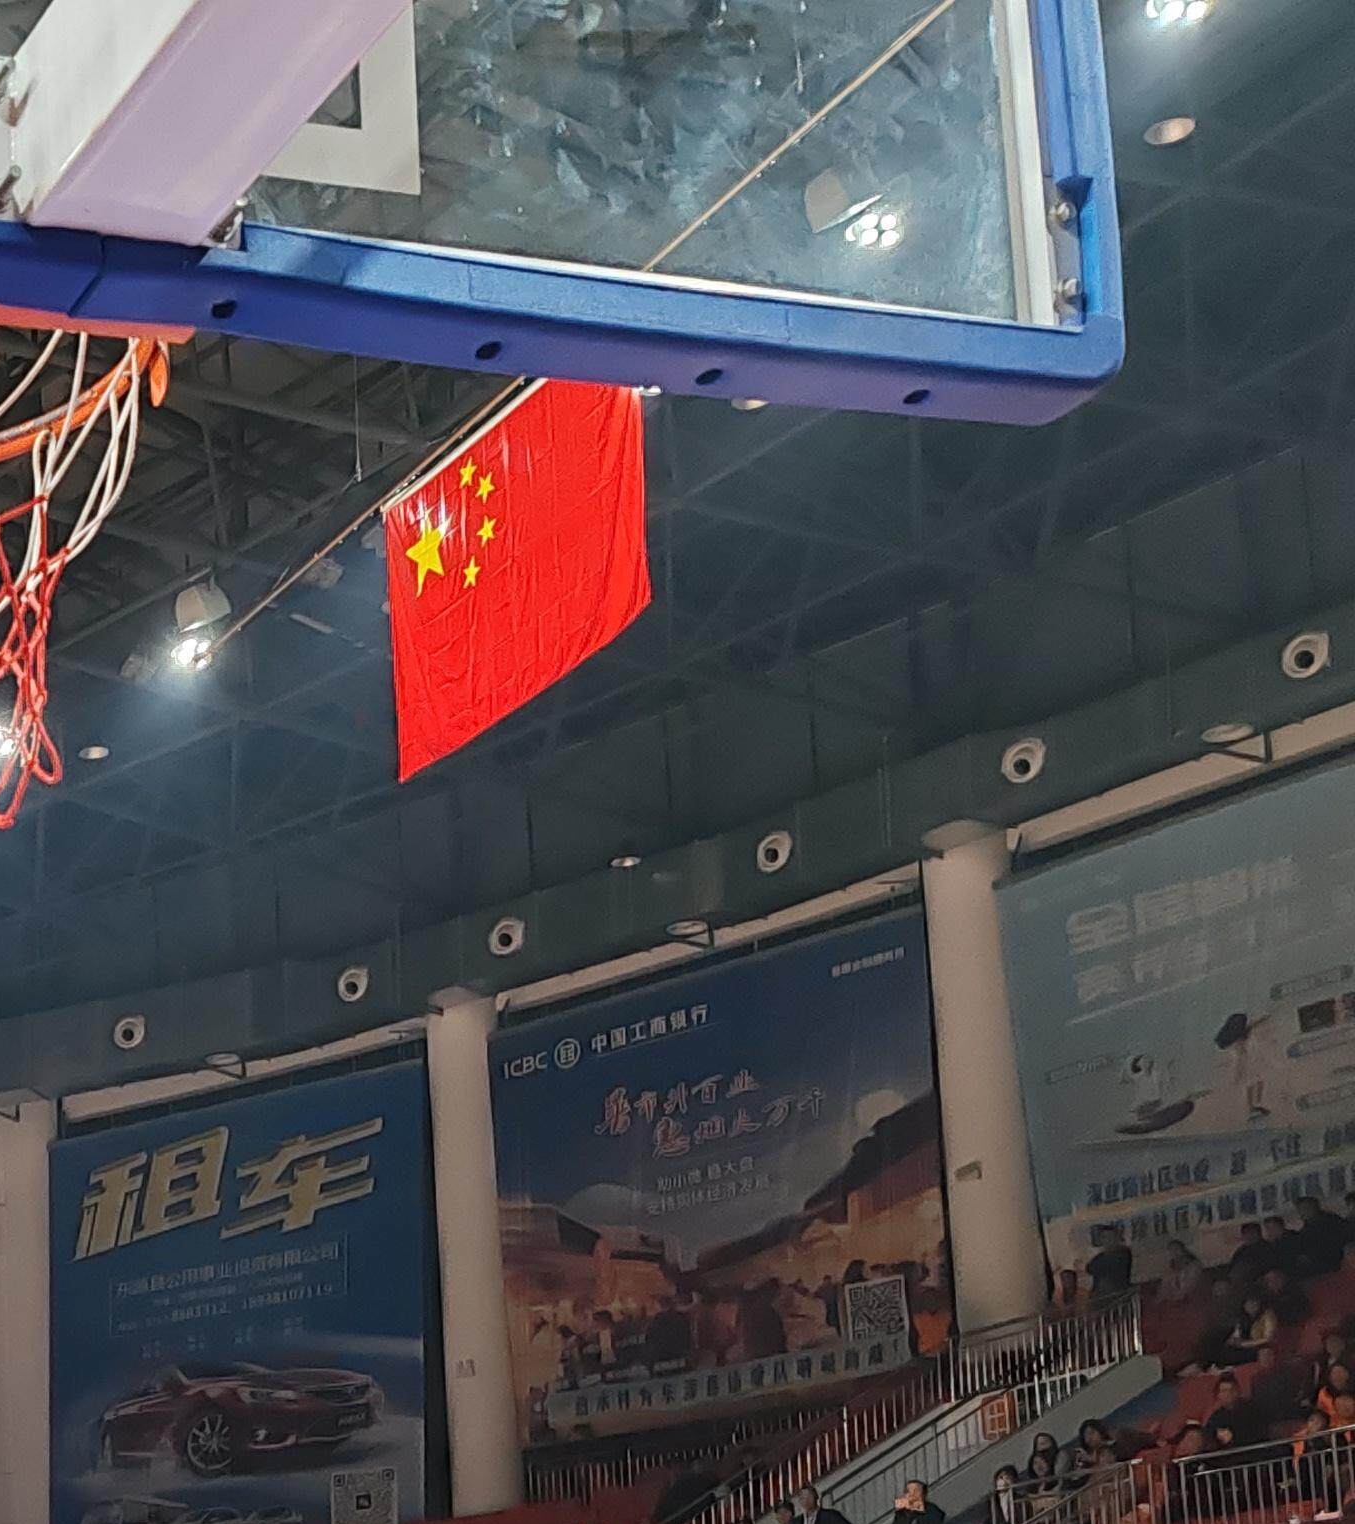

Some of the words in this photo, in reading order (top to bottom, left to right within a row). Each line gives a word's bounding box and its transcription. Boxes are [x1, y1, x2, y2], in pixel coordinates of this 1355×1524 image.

[591, 1002, 710, 1053] 中国工商银行
[504, 1051, 548, 1079] ICBC
[73, 1117, 384, 1263] 租车
